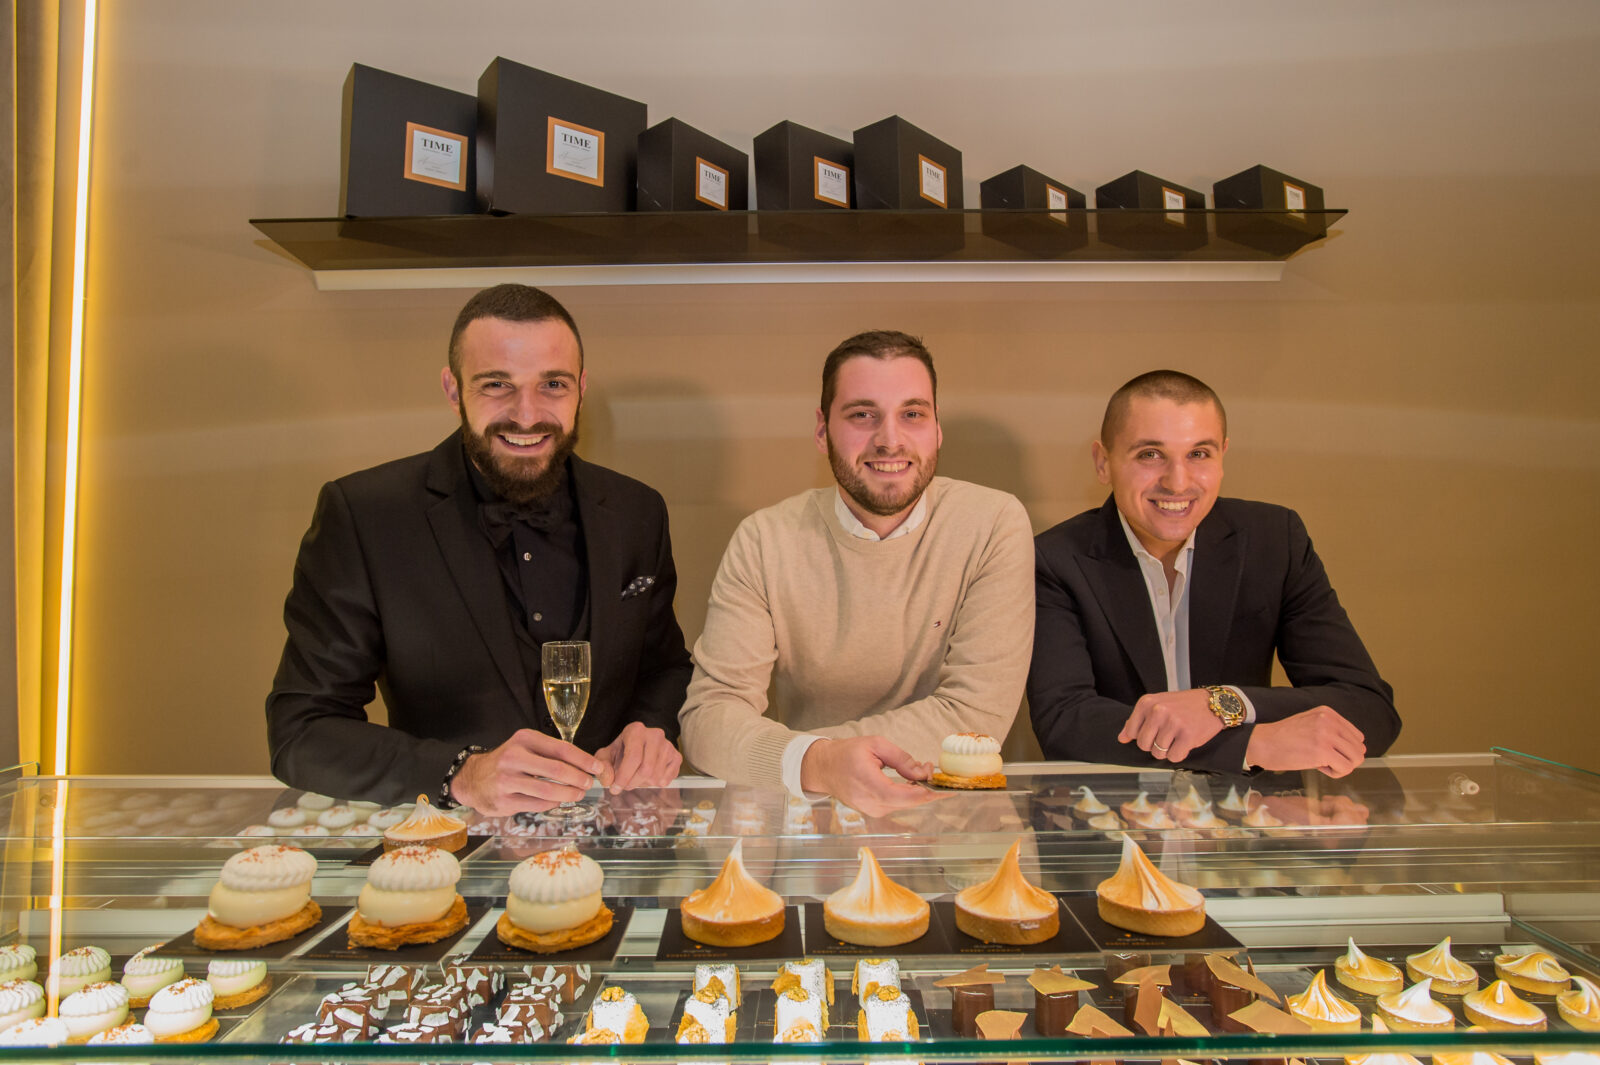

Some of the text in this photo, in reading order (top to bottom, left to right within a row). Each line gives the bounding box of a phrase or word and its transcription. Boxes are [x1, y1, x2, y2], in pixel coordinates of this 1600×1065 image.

[421, 138, 453, 153] TIME
[561, 133, 591, 149] TIME
[704, 169, 721, 182] TIME
[823, 169, 842, 180] TIME
[926, 167, 940, 179] TIME
